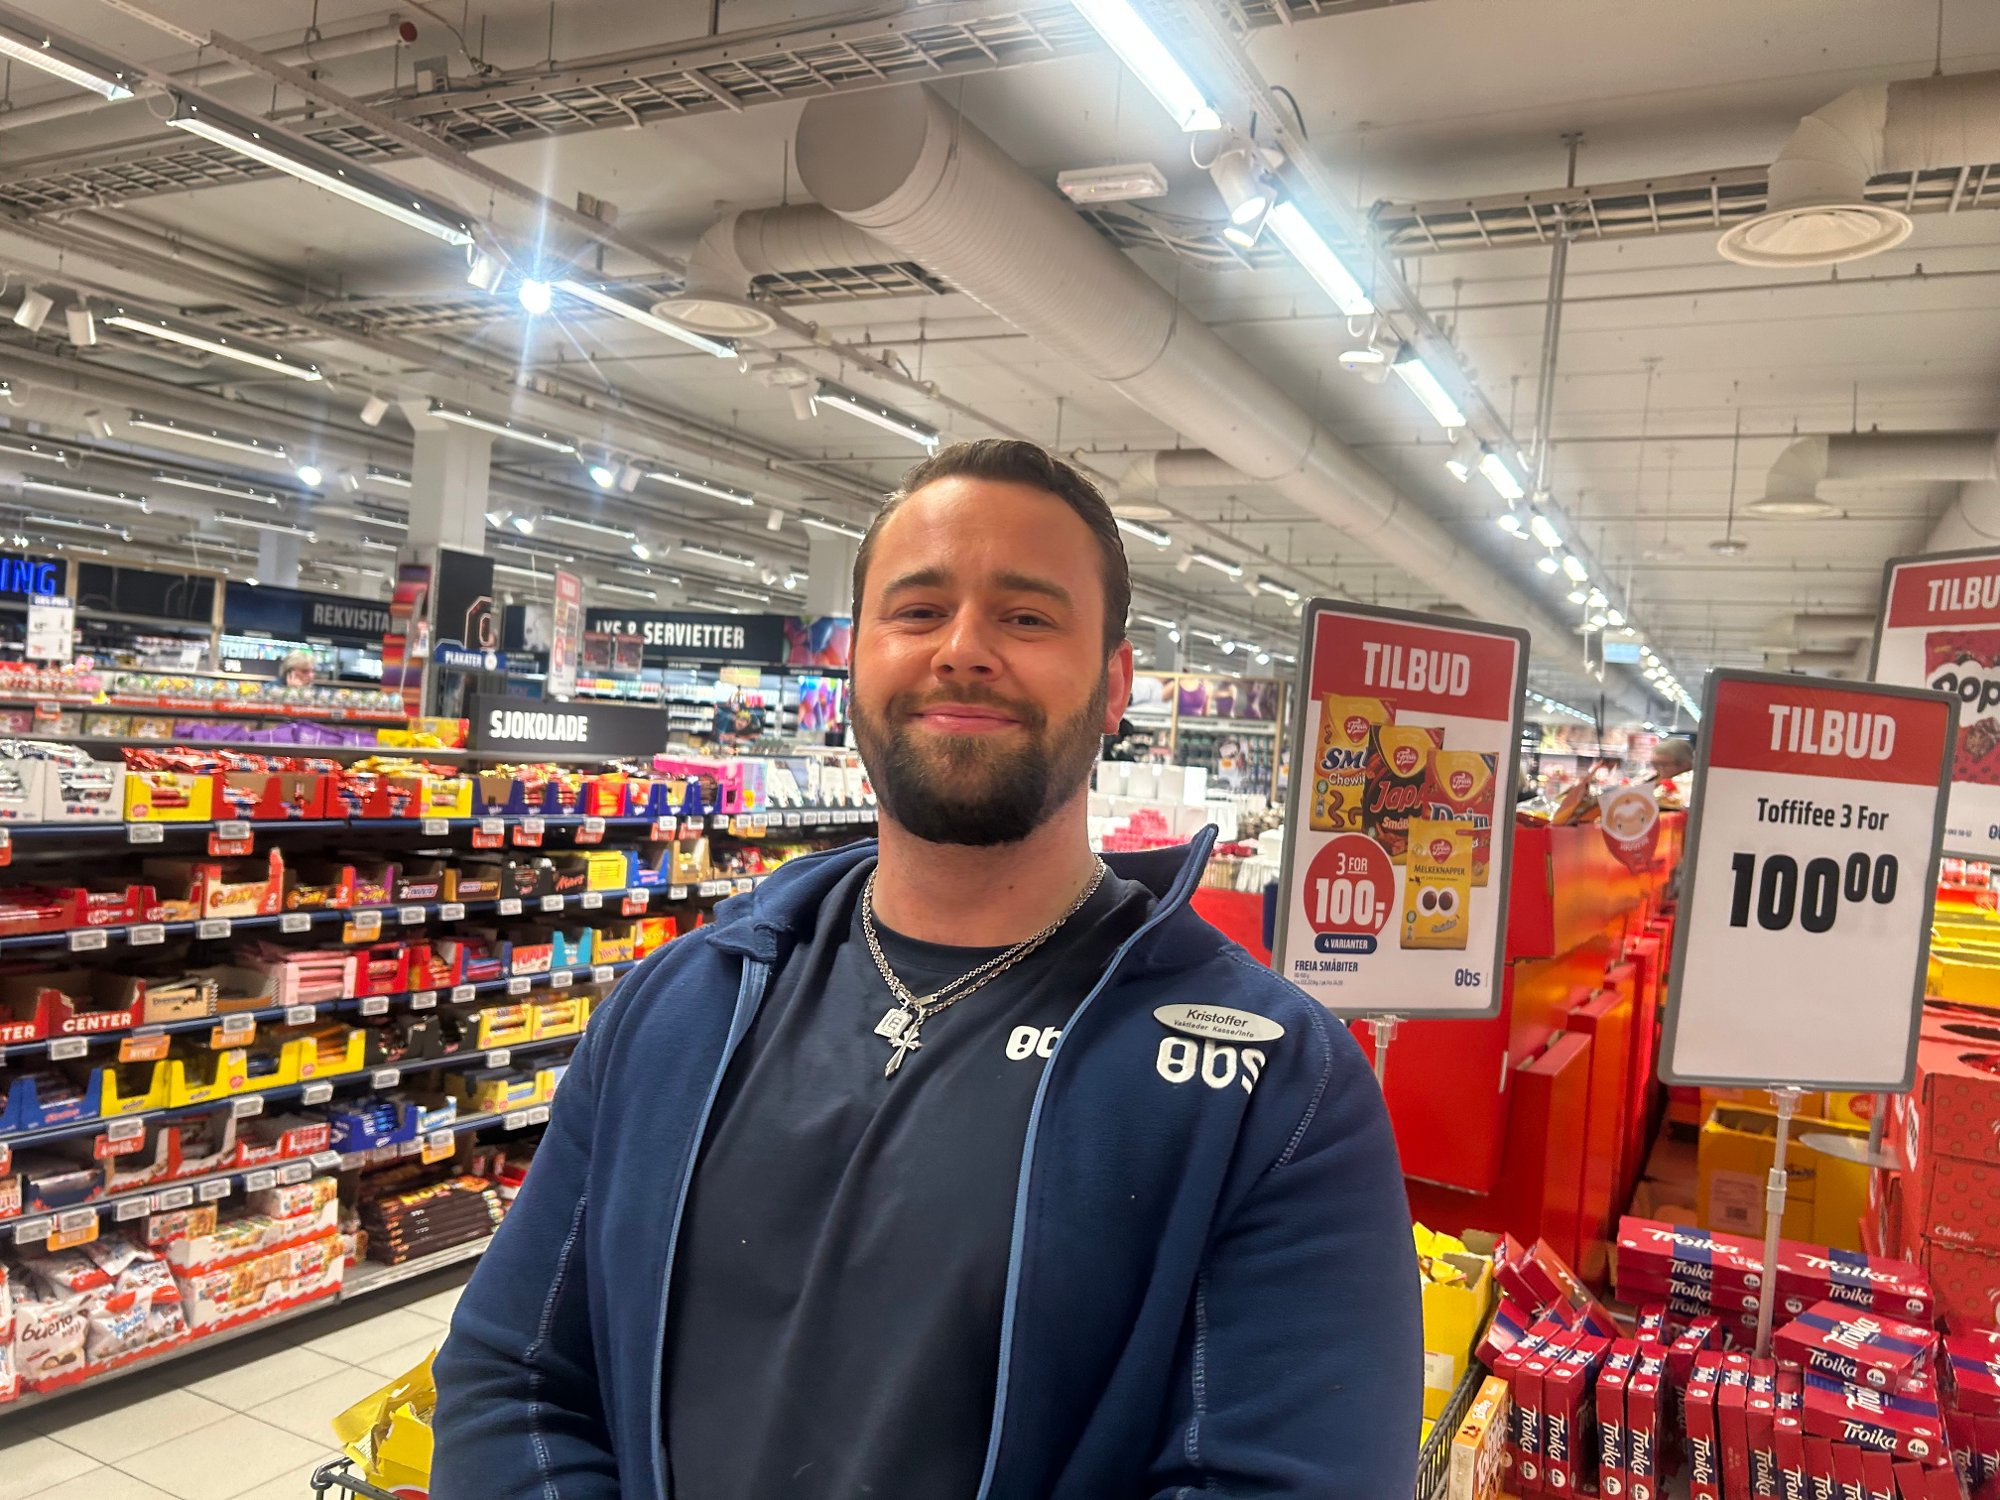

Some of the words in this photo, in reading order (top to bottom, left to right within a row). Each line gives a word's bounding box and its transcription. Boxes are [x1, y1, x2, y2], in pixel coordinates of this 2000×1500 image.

[0, 558, 56, 597] ING
[313, 603, 390, 632] REKVISITA
[643, 622, 745, 649] SERVIETTER
[445, 650, 482, 668] PLAKATER
[1362, 641, 1470, 697] TILBUD
[490, 710, 588, 742] SJOKOLADE
[1768, 704, 1896, 761] TILBUD
[1757, 797, 1835, 827] Toffifee
[1840, 804, 1852, 828] 3
[1857, 805, 1889, 831] For
[1336, 853, 1346, 876] 3
[1348, 857, 1368, 872] FOR
[1413, 864, 1465, 876] MELKEKNAPPER
[1324, 939, 1330, 948] 4
[1331, 939, 1369, 950] VARIANTER
[1294, 959, 1318, 971] FREIA
[1319, 957, 1359, 972] SMÅBITER
[62, 1013, 132, 1033] CENTER
[1186, 1009, 1248, 1027] Kristoffer
[1642, 1227, 1740, 1255] Troika
[1668, 1258, 1714, 1281] Troika
[1796, 1252, 1899, 1284] Troika
[1668, 1278, 1713, 1302] Troika
[1825, 1281, 1874, 1306] Troika
[22, 1313, 73, 1342] bueno
[1822, 1316, 1882, 1350] Troika
[1804, 1348, 1858, 1378] Troika
[1519, 1404, 1538, 1455] Troika
[1546, 1412, 1568, 1462] Troika
[1602, 1418, 1621, 1469] Troika
[1839, 1418, 1898, 1450] Troika
[1630, 1426, 1651, 1477] Troika
[1690, 1434, 1712, 1486] Troika
[1754, 1445, 1776, 1497] Troika
